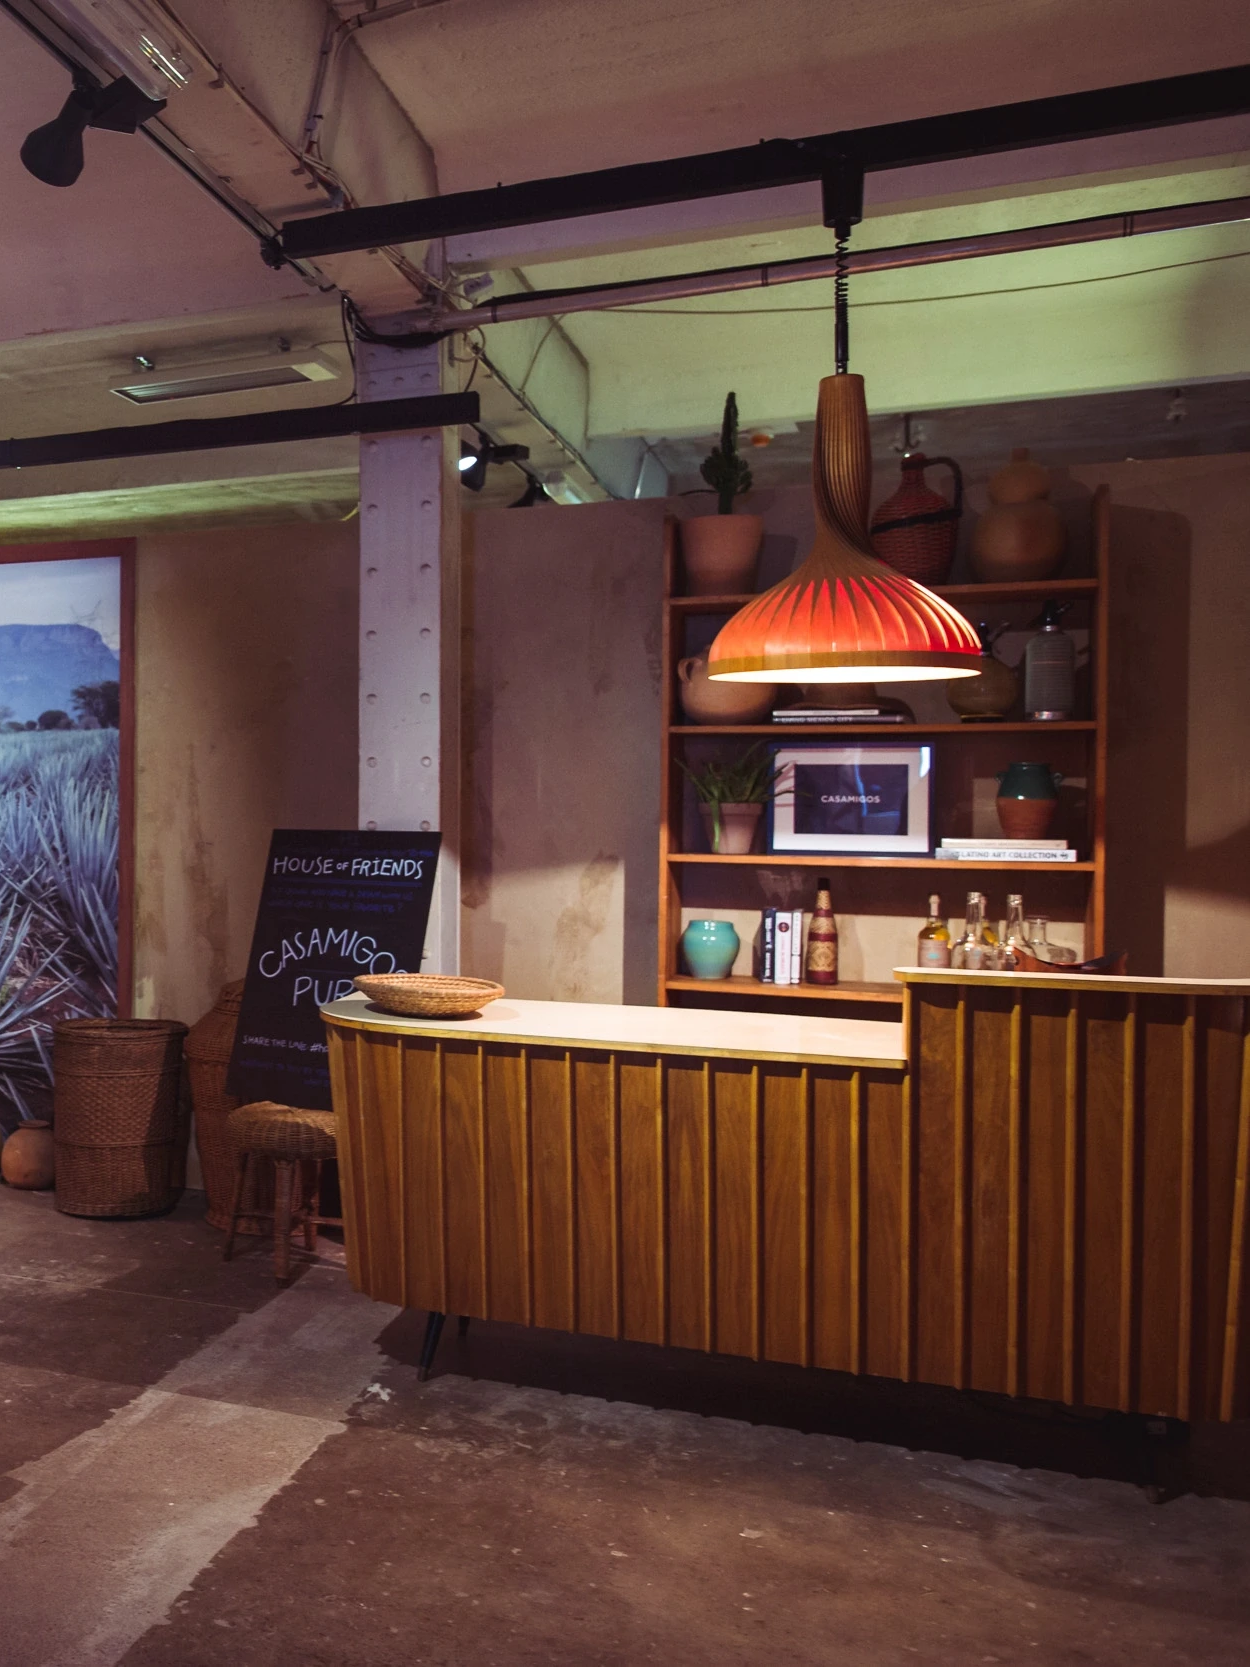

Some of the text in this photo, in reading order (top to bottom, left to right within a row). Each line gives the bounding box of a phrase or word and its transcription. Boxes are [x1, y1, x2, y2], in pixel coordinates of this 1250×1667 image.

[820, 794, 881, 804] CASAMIGOS
[960, 850, 990, 858] LATINO
[992, 851, 1006, 859] ART
[1008, 850, 1058, 859] COLLECTION
[273, 855, 424, 880] HOUSE OF FRIENDS
[258, 927, 409, 979] CASAMIGO
[242, 1034, 270, 1047] SHARE
[270, 1038, 287, 1048] THE
